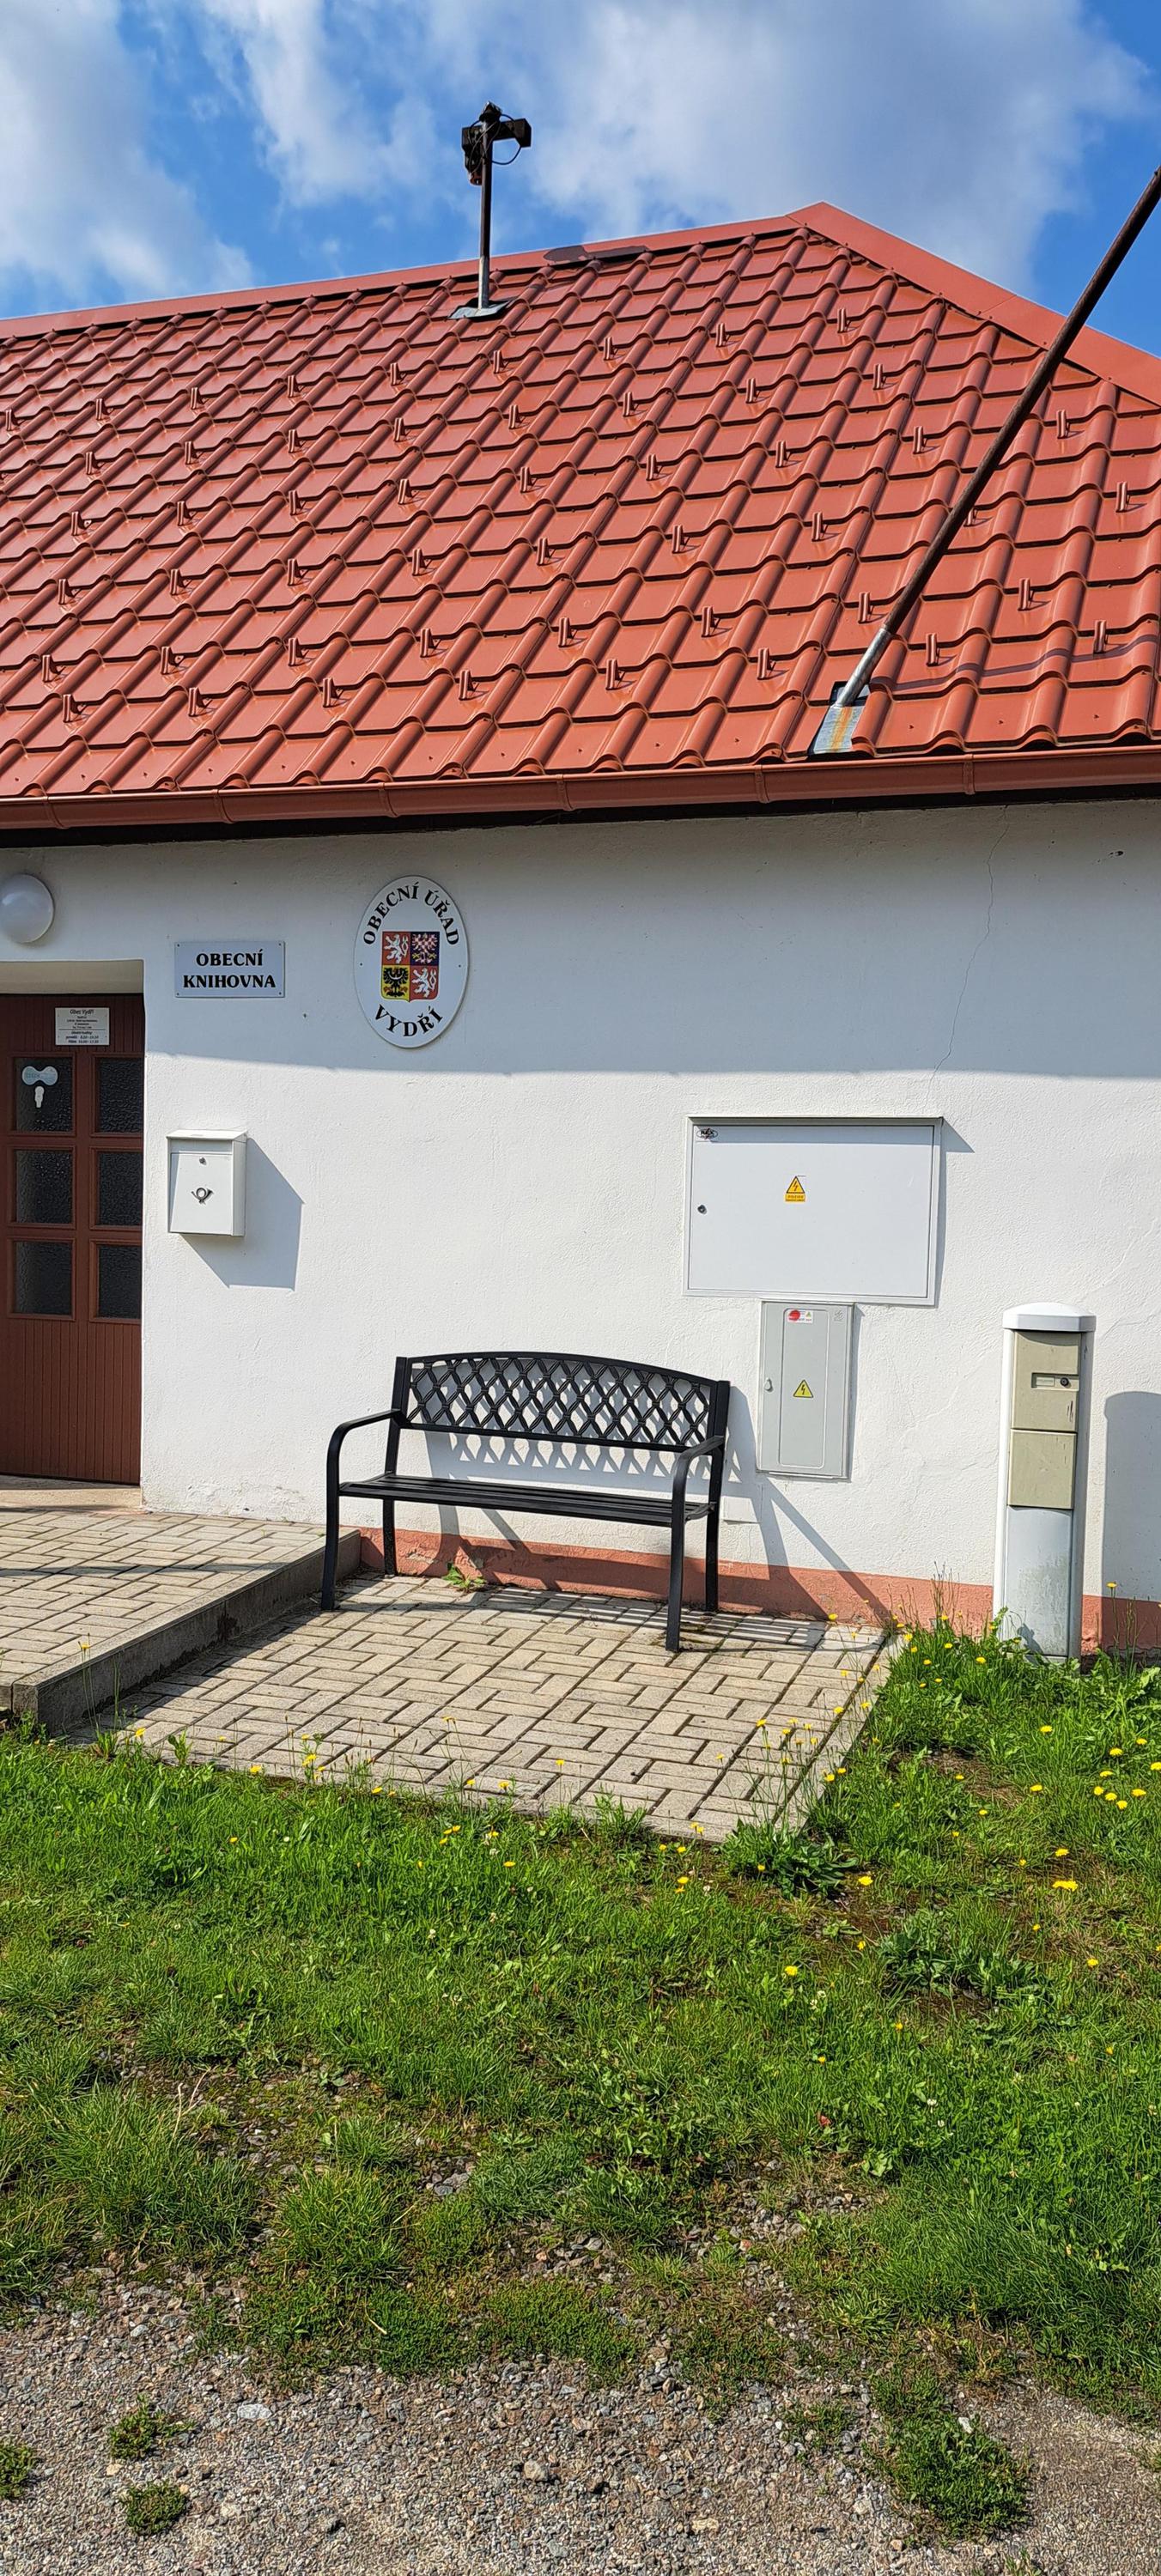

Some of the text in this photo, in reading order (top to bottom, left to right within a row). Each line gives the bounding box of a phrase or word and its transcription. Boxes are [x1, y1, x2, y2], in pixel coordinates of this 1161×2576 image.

[363, 882, 459, 945] OBECNÍ ÚŘAD
[196, 948, 263, 966] OBECNÍ
[183, 975, 276, 987] KNIHOVNA
[374, 1004, 443, 1036] VYDŘÍ
